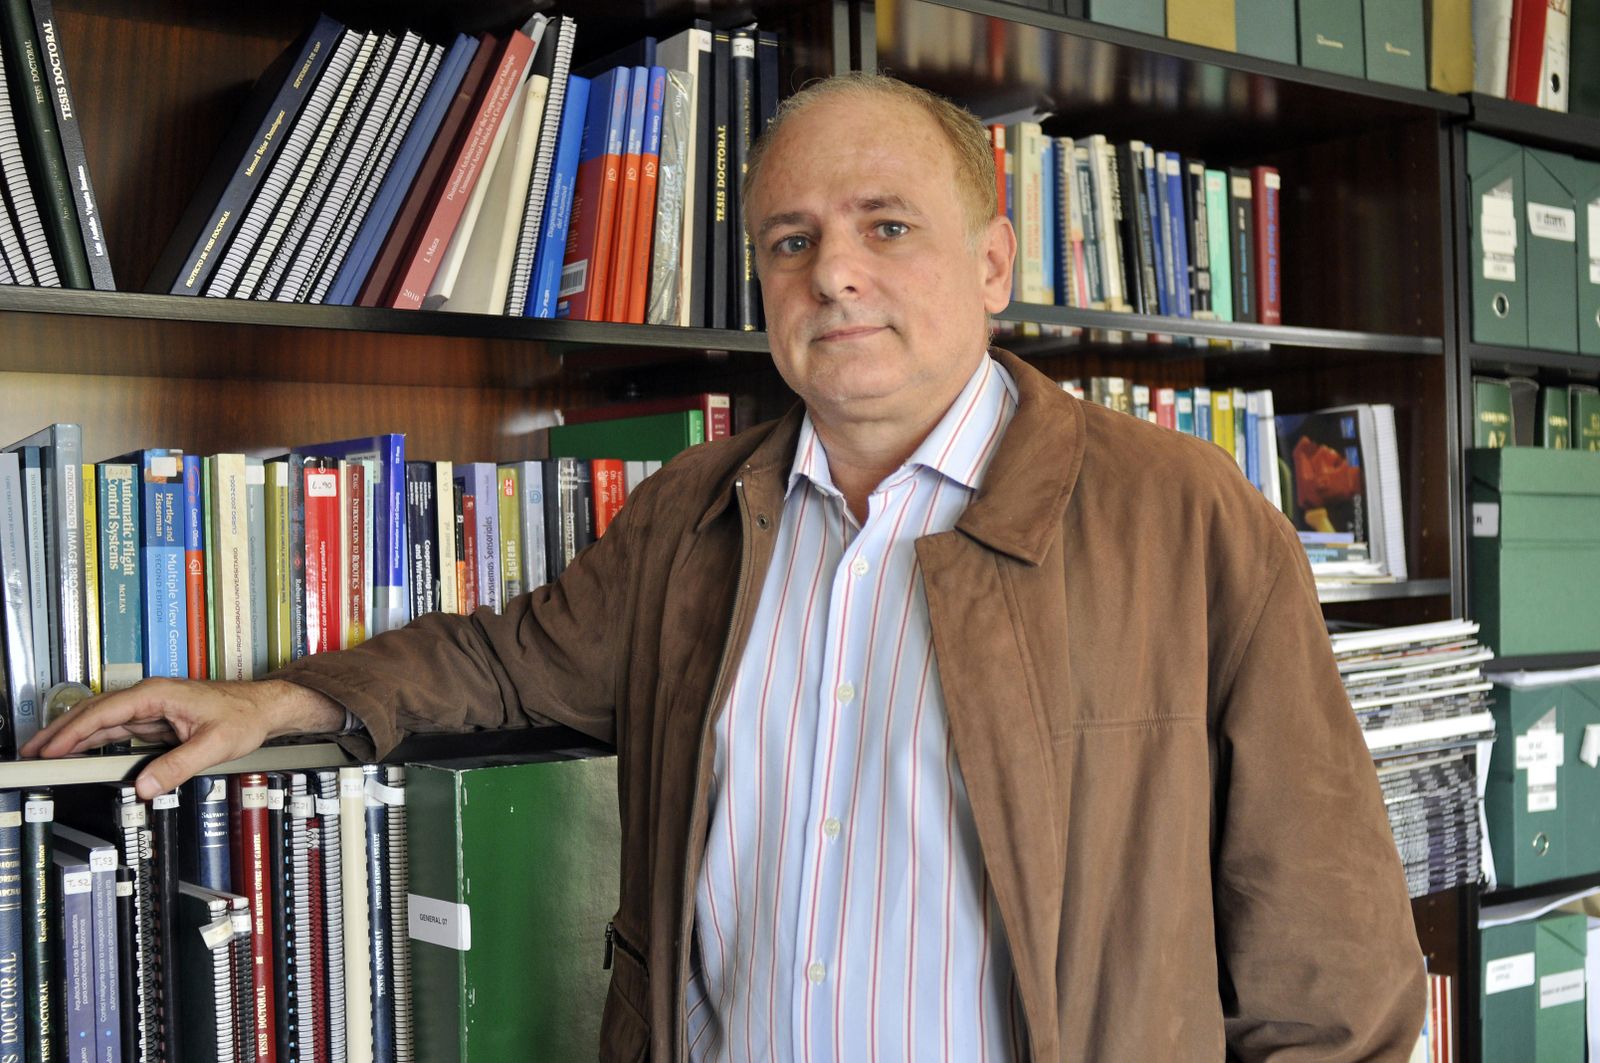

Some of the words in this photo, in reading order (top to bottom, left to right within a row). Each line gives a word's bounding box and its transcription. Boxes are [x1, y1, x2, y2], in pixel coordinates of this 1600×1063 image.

[23, 38, 40, 83] DOCTORAL
[41, 18, 65, 86] DOCTORAL
[34, 84, 45, 104] TESIS
[56, 85, 73, 121] TESIS
[474, 125, 484, 136] for
[478, 115, 488, 128] the
[243, 153, 261, 177] Manuel
[459, 134, 480, 169] Architecture
[715, 123, 726, 188] DOCTORAL
[445, 167, 465, 201] Distributed
[458, 161, 477, 194] Unmanned
[715, 190, 725, 222] TESIS
[210, 208, 231, 240] DOCTORAL
[199, 250, 208, 260] DE
[203, 236, 216, 252] TESIS
[184, 257, 205, 288] PROYECTO
[401, 287, 421, 304] 2010
[66, 465, 75, 515] INTRODUCTION
[106, 478, 120, 520] Control
[67, 515, 75, 527] TO
[120, 477, 135, 538] Automatic
[152, 491, 165, 537] Zisserman
[162, 492, 175, 524] Hartley
[351, 497, 360, 544] INTRODUCTION
[67, 530, 77, 565] IMAGE
[84, 518, 93, 559] ADAPTIVE
[107, 520, 121, 570] Systems
[165, 524, 174, 542] and
[482, 514, 493, 560] Sensoriales
[118, 539, 136, 577] Flight
[319, 539, 327, 582] programables
[414, 543, 422, 560] and
[423, 539, 433, 590] Cooperating
[504, 538, 518, 576] Systems
[153, 553, 162, 587] SECOND
[164, 552, 178, 599] Multiple
[232, 546, 240, 600] UNIVERSITARIO
[350, 554, 360, 589] ROBOTICS
[415, 559, 424, 594] Wireless
[486, 560, 495, 595] Sistemas
[154, 589, 164, 623] EDITION
[294, 577, 302, 603] Robust
[425, 590, 433, 613] Embe
[167, 600, 179, 627] View
[234, 600, 242, 652] PROFESORADO
[294, 603, 303, 648] Autonomous
[168, 628, 180, 677] Geometr
[34, 843, 45, 869] Ramos
[254, 858, 262, 869] DE
[36, 905, 46, 917] N.
[254, 891, 263, 916] MANUEL
[419, 913, 442, 925] GENERAL
[36, 917, 47, 943] Raquel
[98, 957, 106, 972] para
[374, 927, 384, 971] DOCTORAL
[0, 951, 19, 1044] DOCTORAL
[375, 973, 385, 997] TESIS
[38, 979, 49, 1035] DOCTORAL
[256, 983, 267, 1029] DOCTORAL
[39, 1037, 50, 1062] TESIS
[257, 1032, 268, 1057] TESIS
